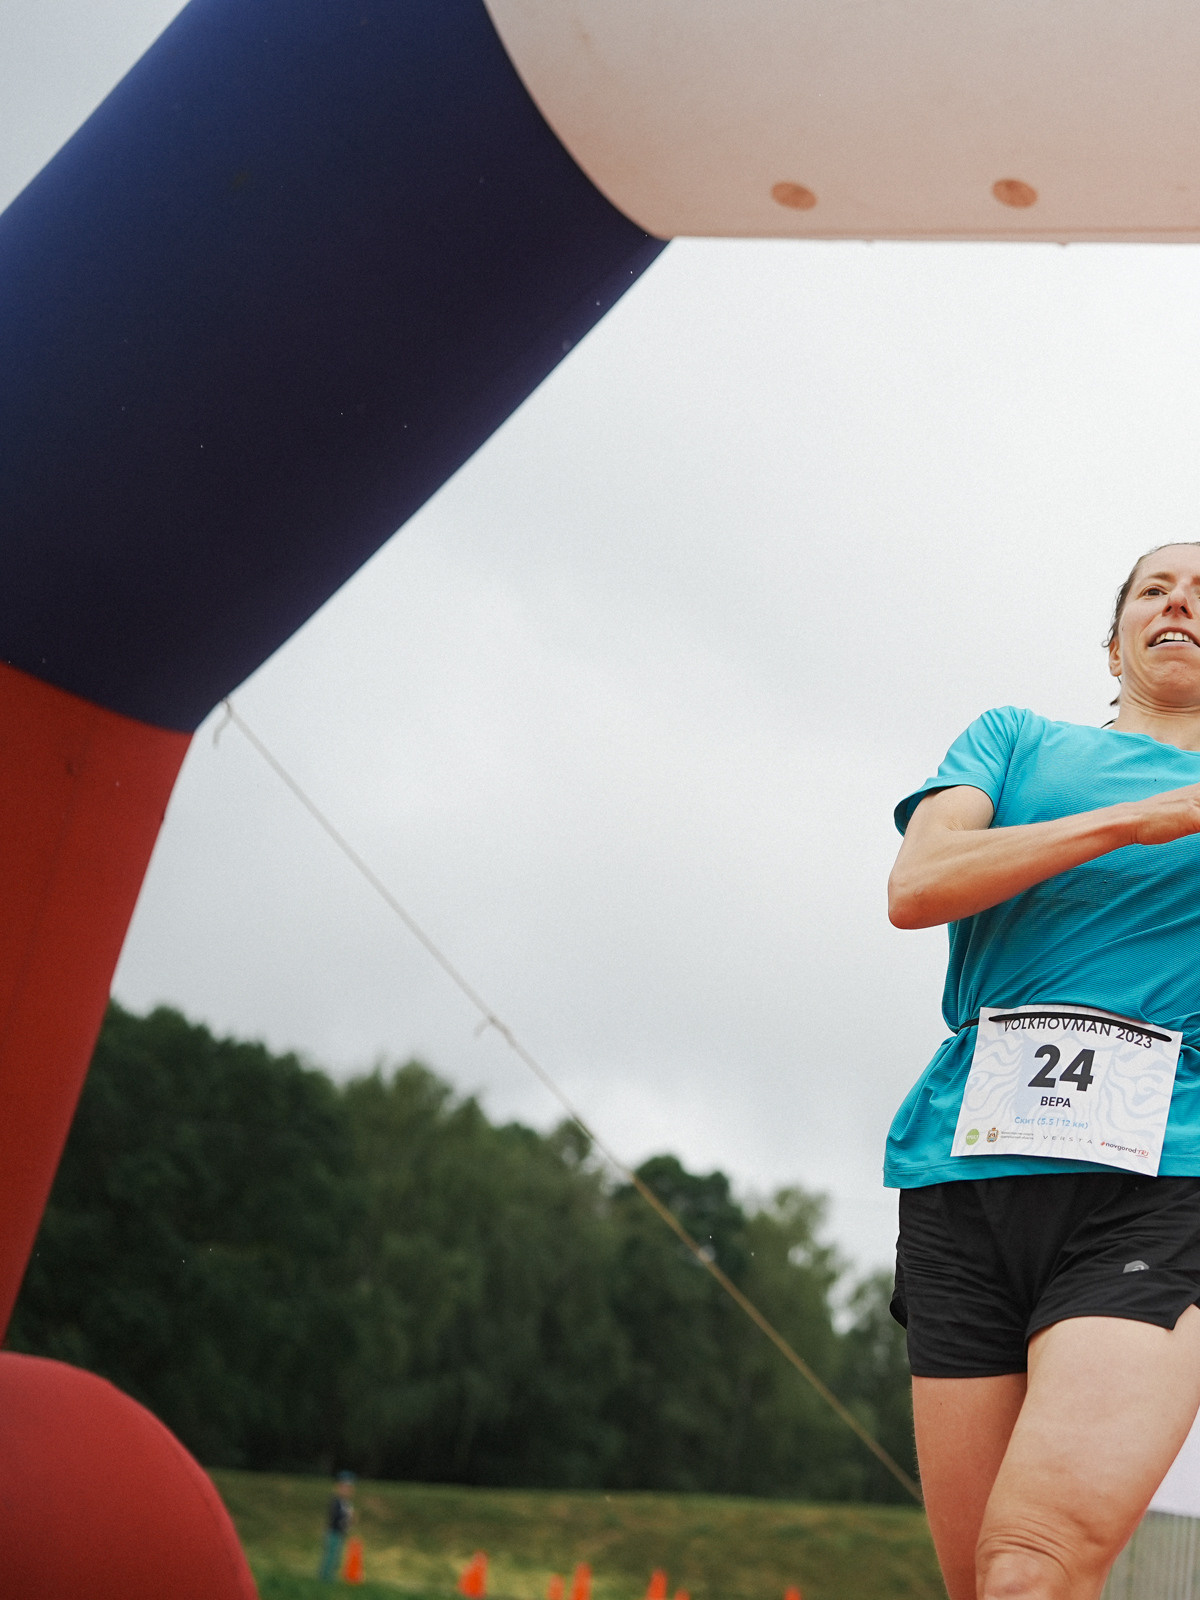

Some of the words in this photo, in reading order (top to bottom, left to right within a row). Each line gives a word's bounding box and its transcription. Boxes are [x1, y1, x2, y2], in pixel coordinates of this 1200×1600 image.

[1004, 1017, 1111, 1036] VOLKHOVMAN
[1115, 1028, 1153, 1049] 2023
[1027, 1044, 1096, 1092] 24
[1040, 1096, 1071, 1108] ВЕРА
[1014, 1116, 1034, 1125] Скит
[1061, 1119, 1071, 1127] 12
